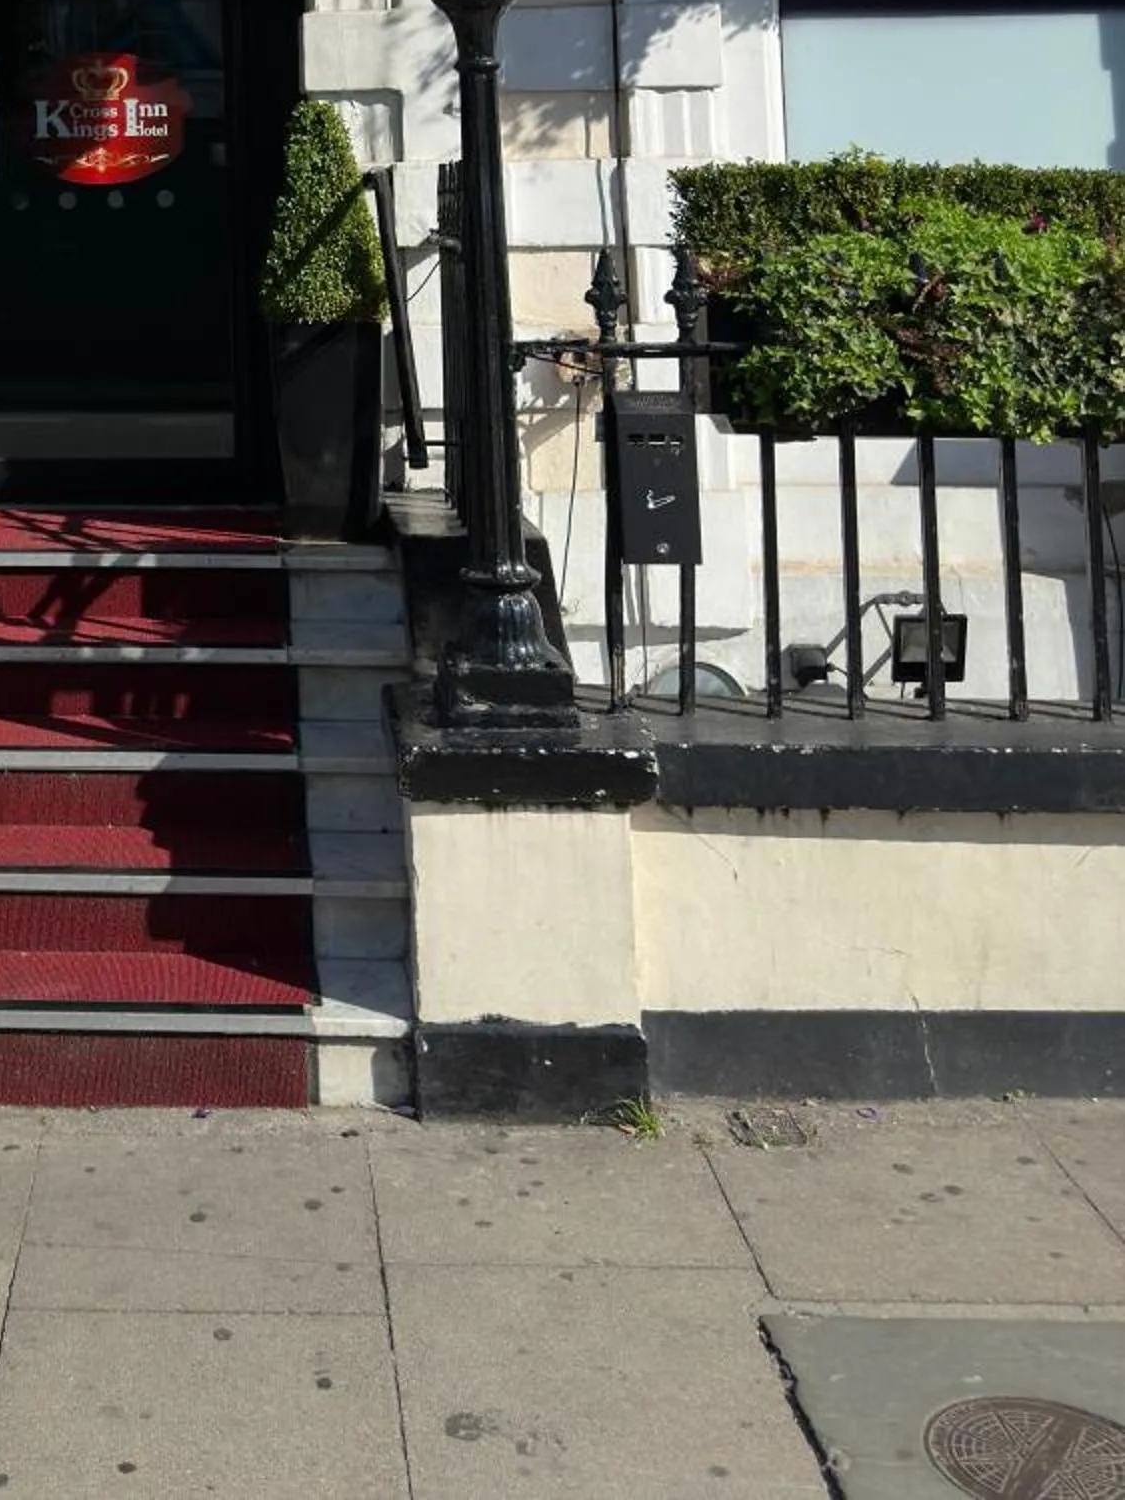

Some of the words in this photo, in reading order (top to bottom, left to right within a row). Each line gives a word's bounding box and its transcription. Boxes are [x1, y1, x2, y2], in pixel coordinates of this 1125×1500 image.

[34, 99, 118, 140] Kings
[70, 102, 118, 119] Cross
[123, 98, 169, 137] Inn
